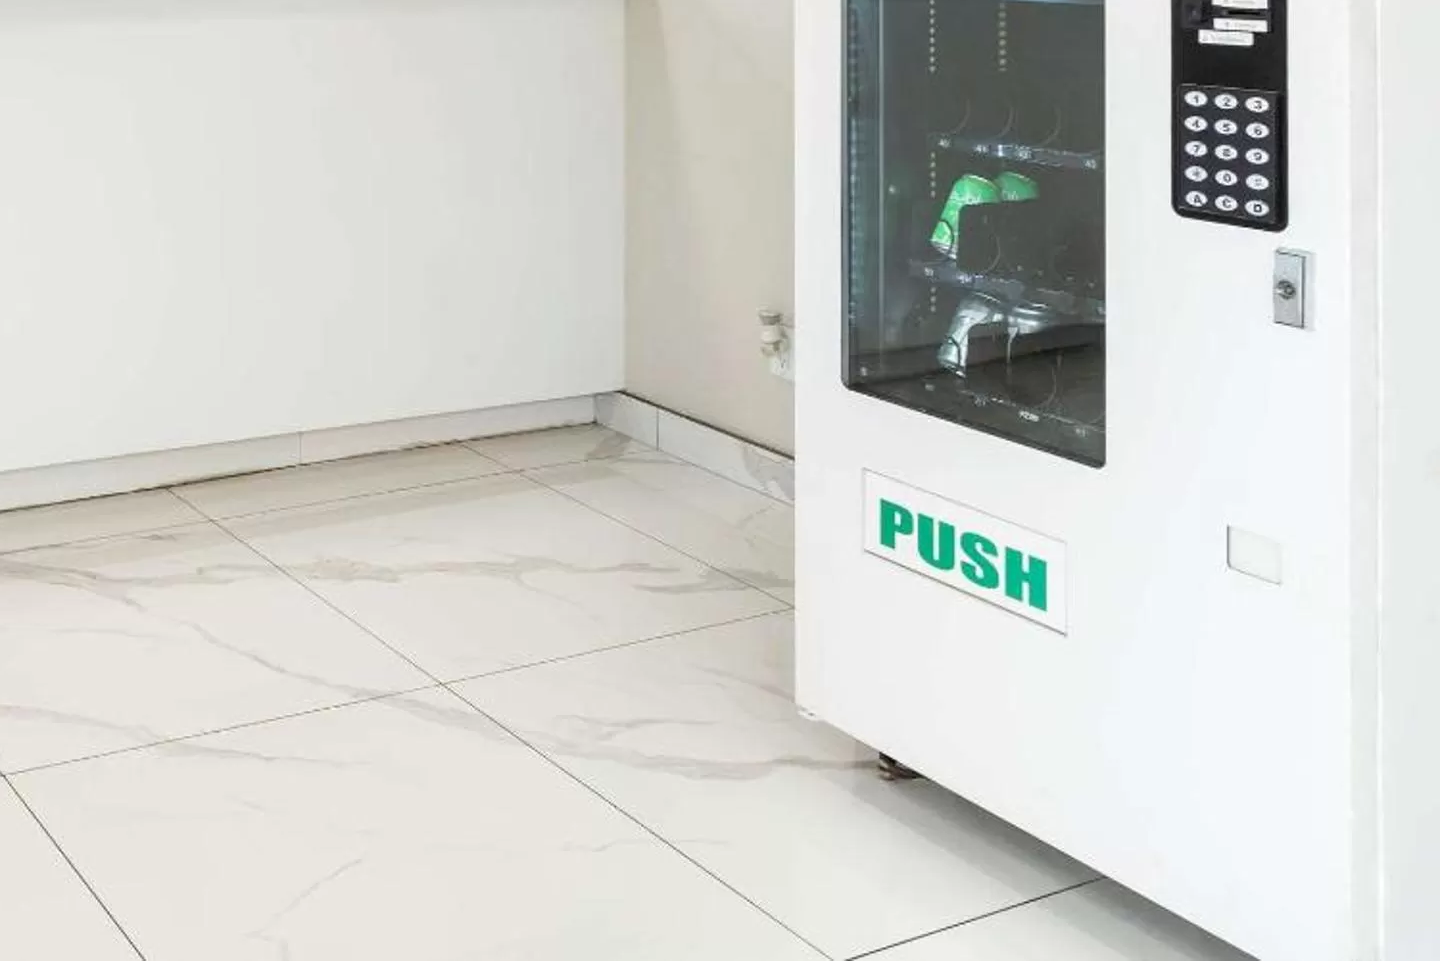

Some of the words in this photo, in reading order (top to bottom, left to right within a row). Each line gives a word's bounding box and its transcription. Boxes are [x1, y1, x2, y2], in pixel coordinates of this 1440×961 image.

[1193, 95, 1199, 103] 1
[1223, 97, 1231, 107] 2
[1254, 100, 1262, 109] 3
[1192, 119, 1200, 128] 4
[1222, 123, 1231, 132] 5
[1254, 126, 1262, 136] 6
[1193, 144, 1200, 153] 7
[1254, 152, 1262, 161] 9
[1223, 173, 1231, 182] 0
[1193, 194, 1202, 204] A
[1222, 199, 1232, 208] C
[879, 498, 1048, 612] PUSH
